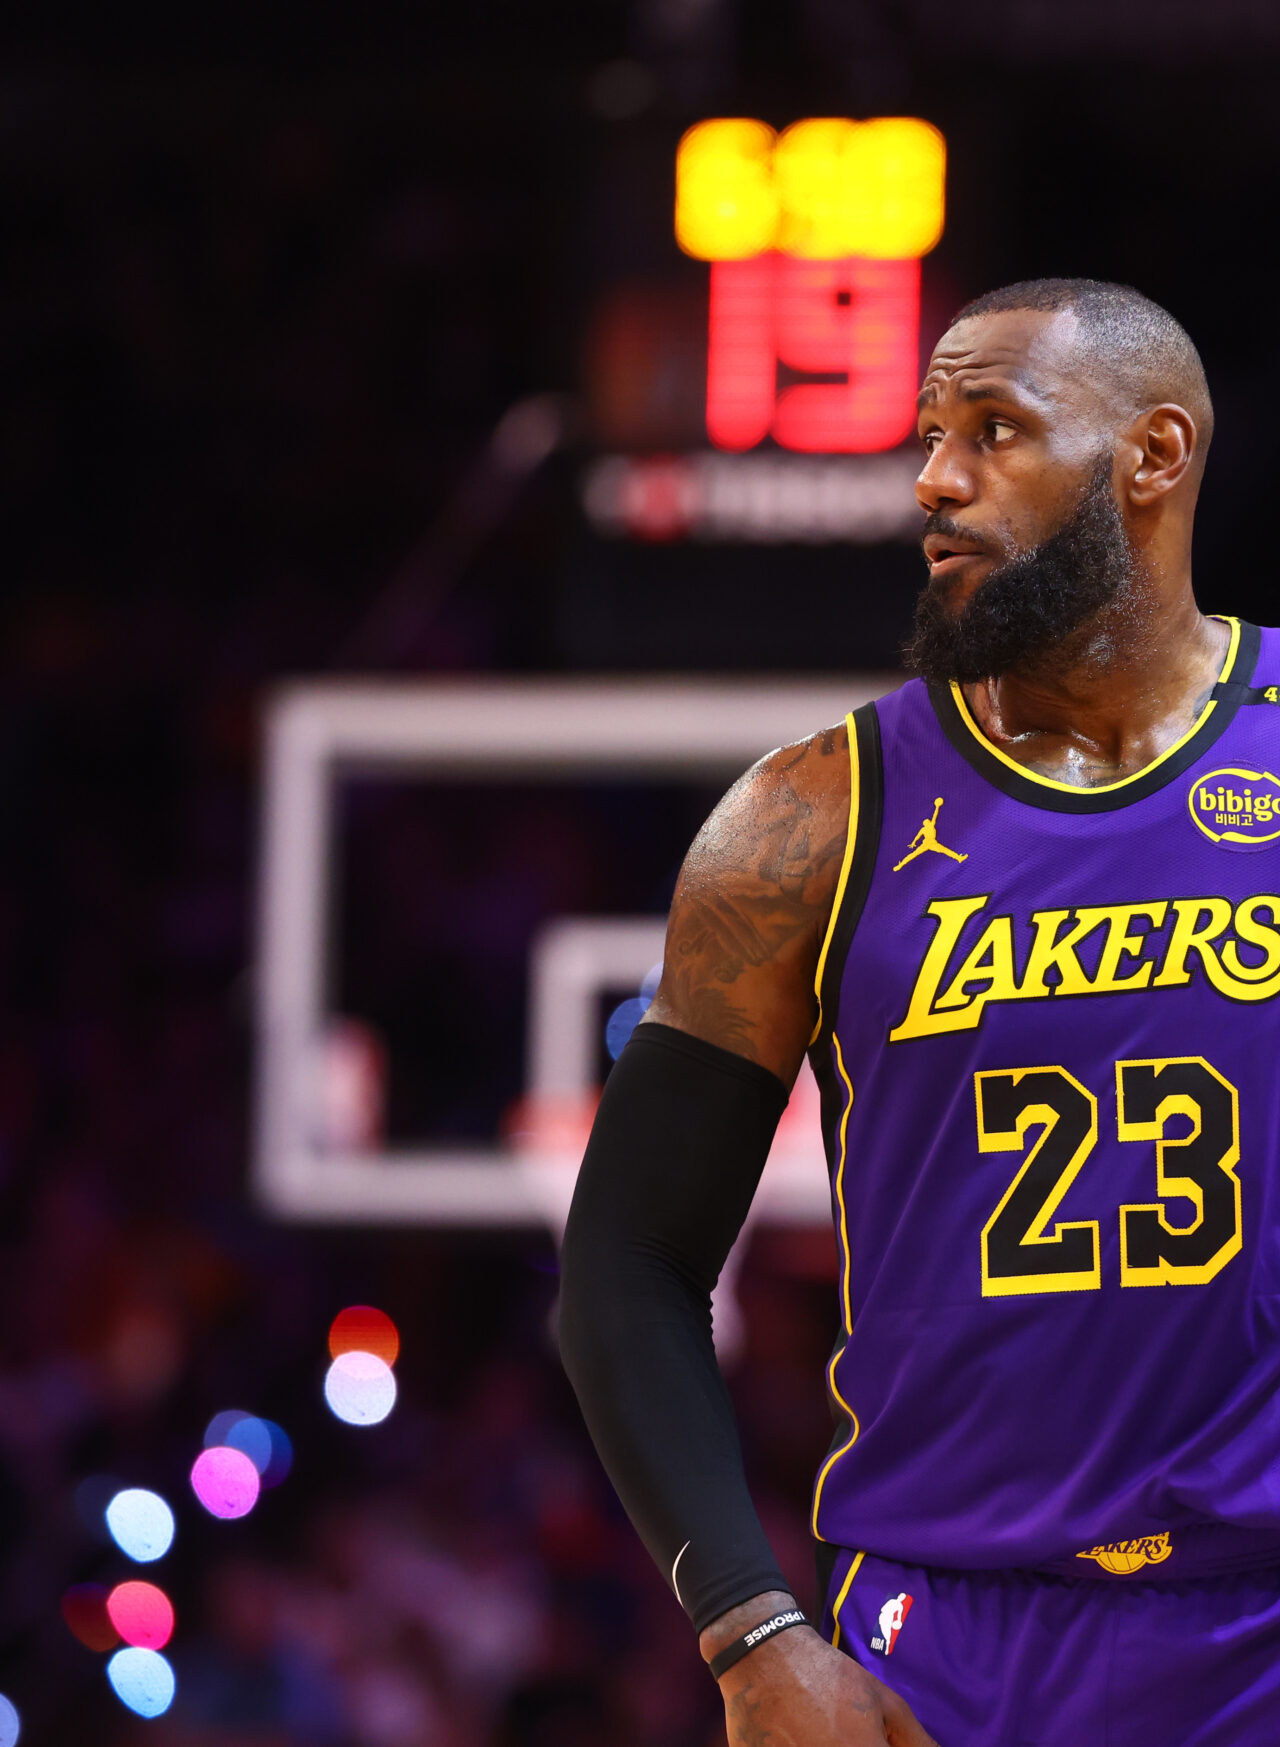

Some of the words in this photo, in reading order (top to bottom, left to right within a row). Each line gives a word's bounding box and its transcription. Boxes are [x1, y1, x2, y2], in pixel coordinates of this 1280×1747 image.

[1215, 813, 1254, 826] 비비고
[974, 1056, 1243, 1297] 23
[870, 1636, 885, 1651] NBA
